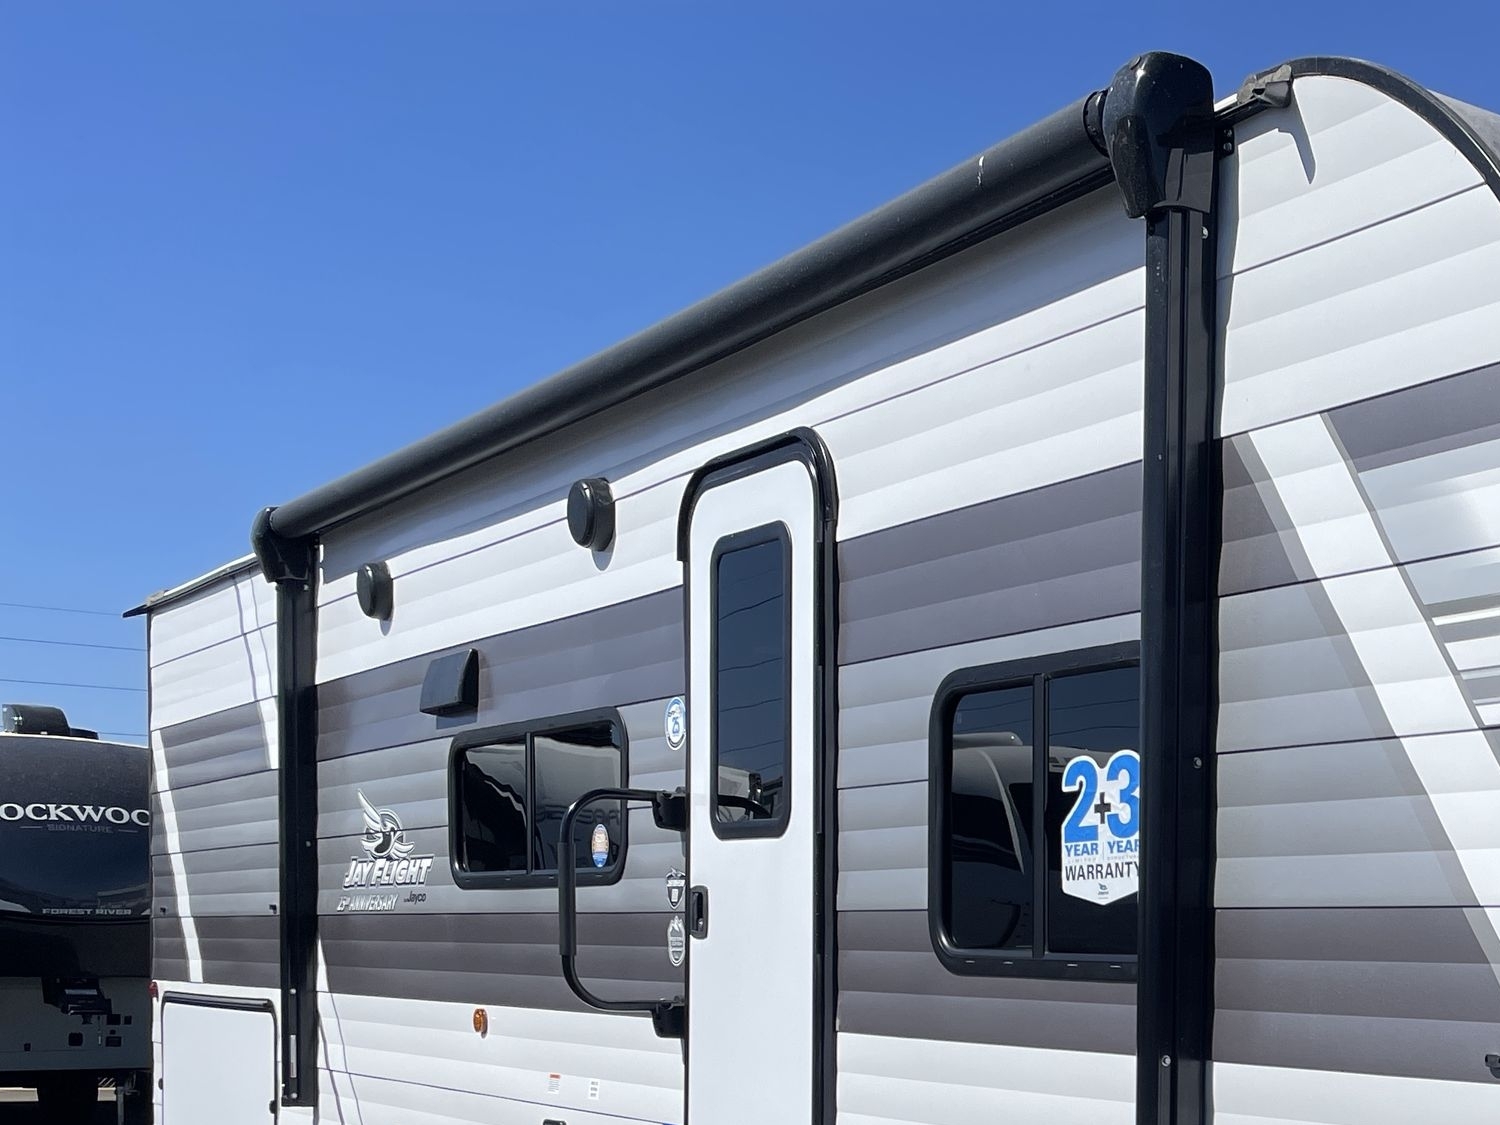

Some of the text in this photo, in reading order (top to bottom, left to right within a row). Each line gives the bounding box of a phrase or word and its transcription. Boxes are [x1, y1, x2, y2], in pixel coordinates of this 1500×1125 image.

[47, 823, 113, 834] SIGNATURE
[1065, 842, 1099, 857] YEAR
[344, 857, 433, 888] JAY FLIGHT
[349, 894, 398, 911] ANNIVERSARY
